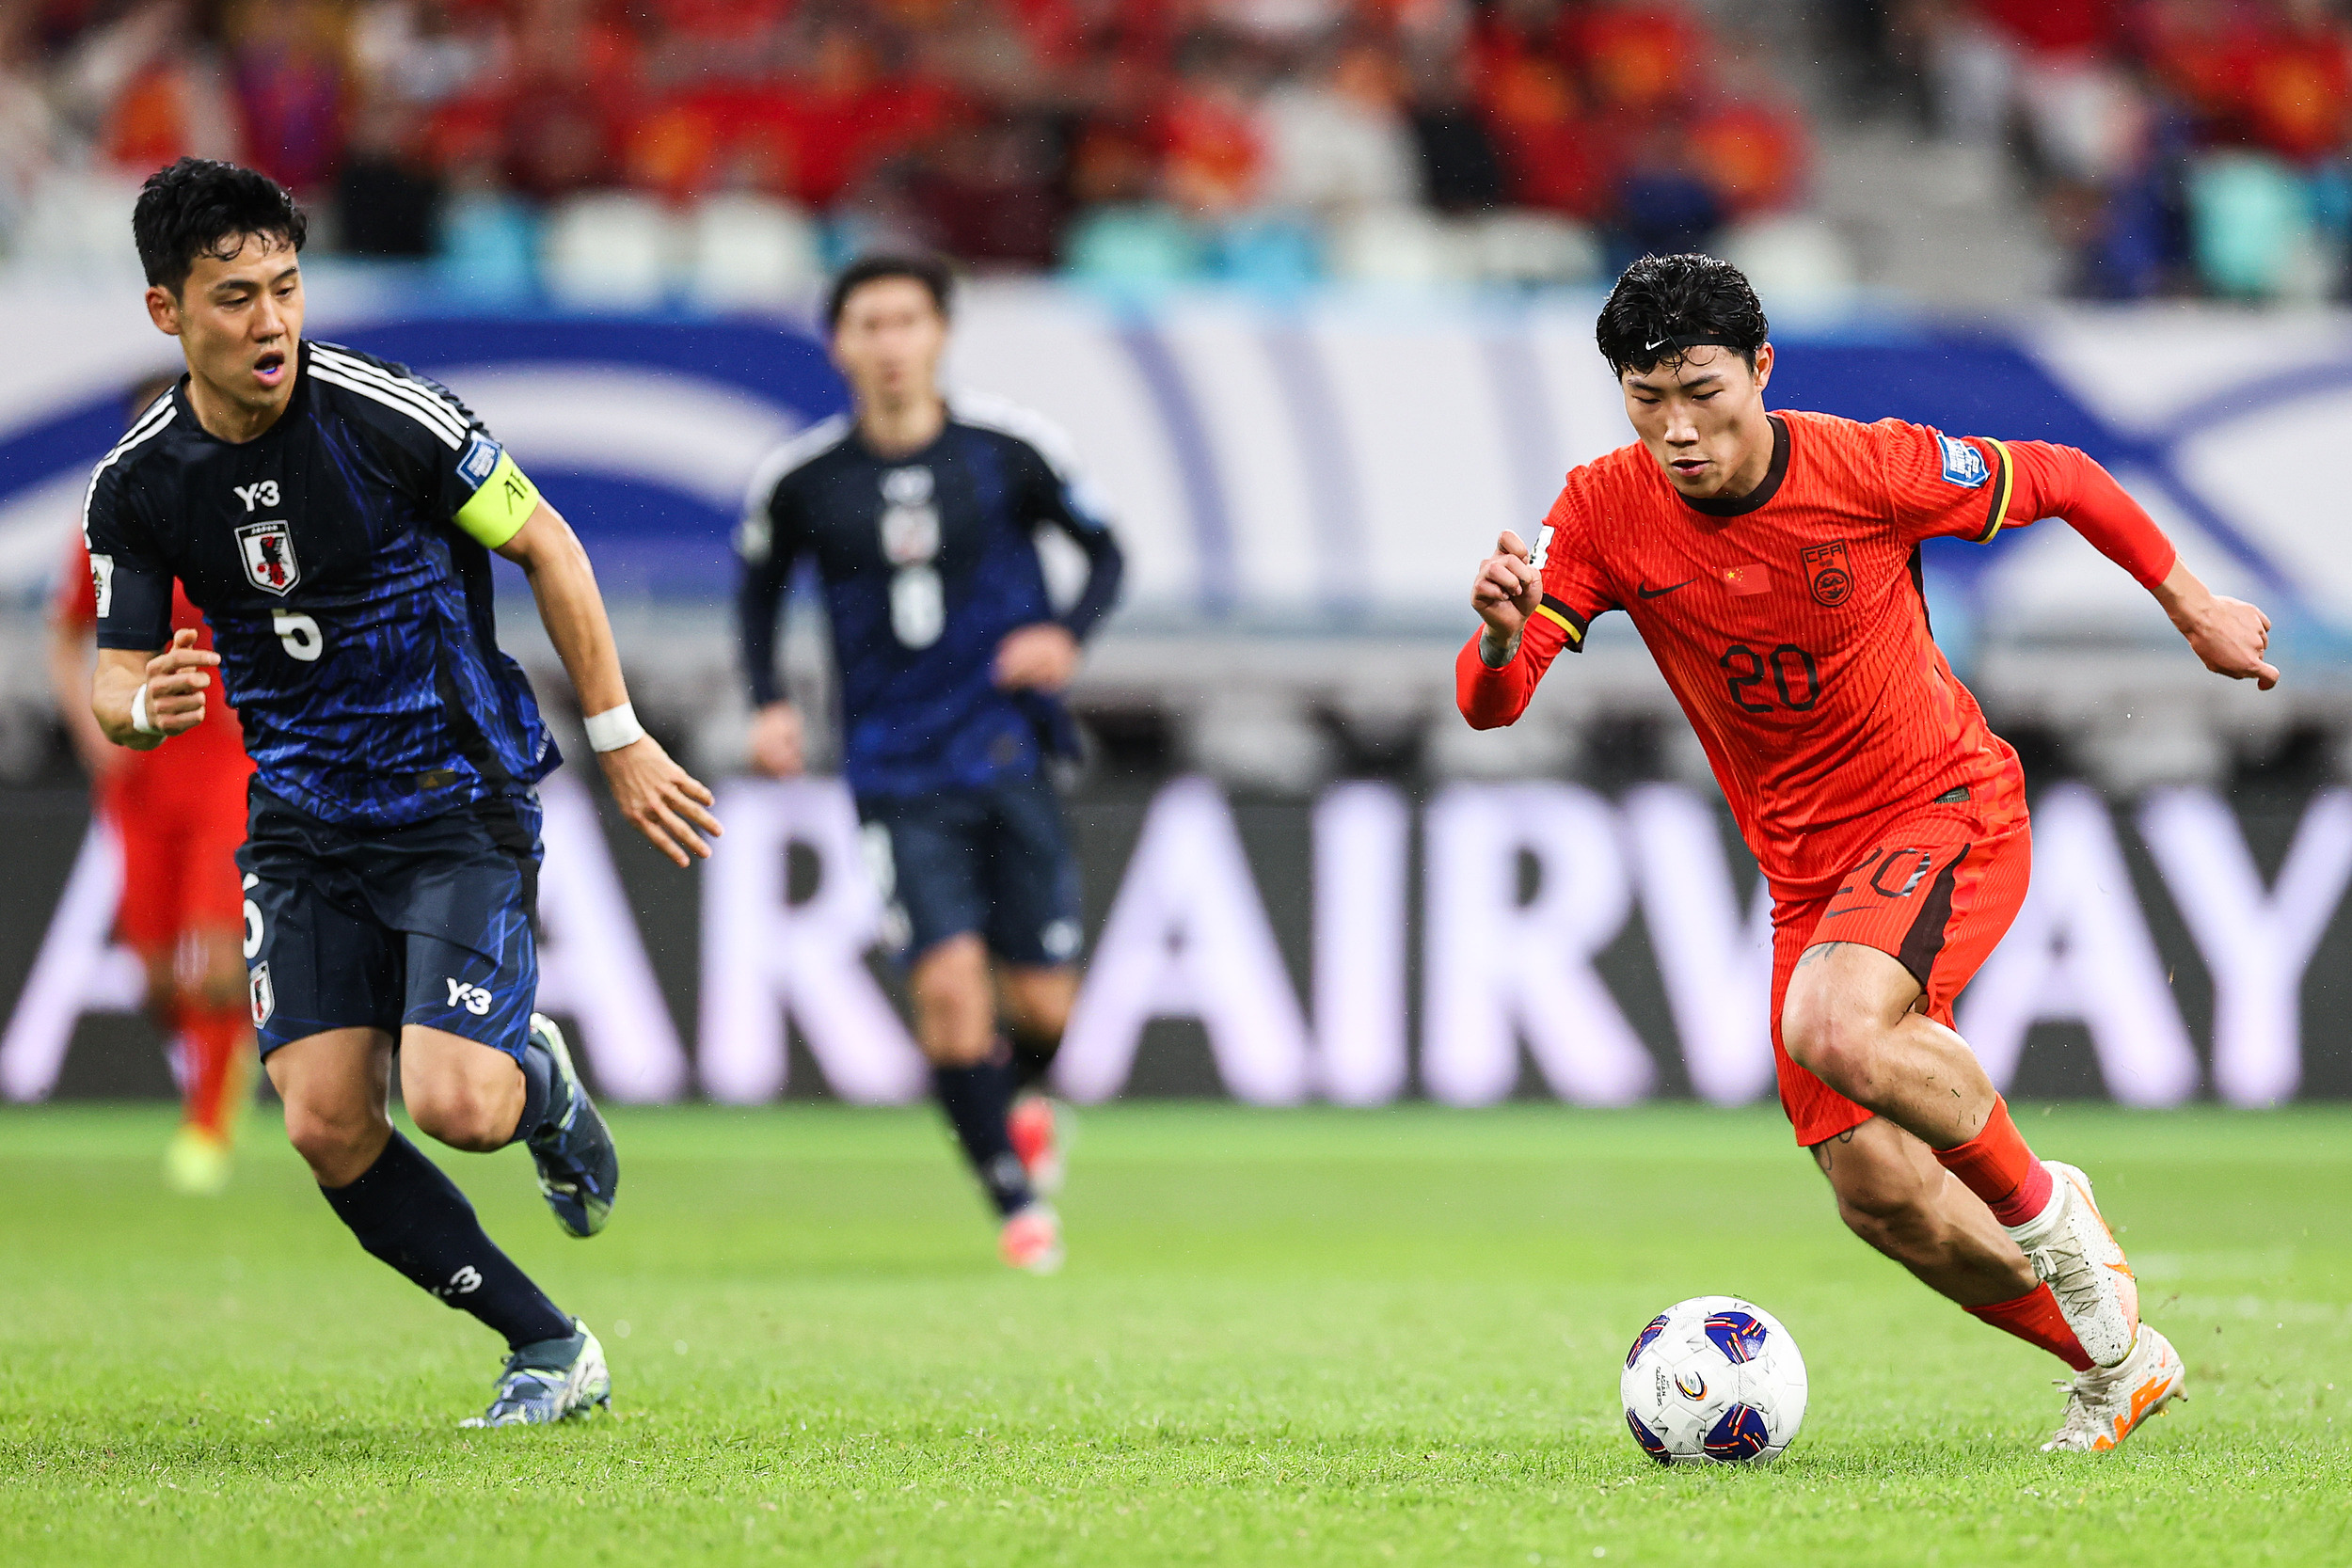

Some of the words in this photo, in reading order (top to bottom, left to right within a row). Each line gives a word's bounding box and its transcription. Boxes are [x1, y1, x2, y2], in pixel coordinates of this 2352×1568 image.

[1805, 545, 1842, 562] CFA
[1720, 643, 1820, 713] 20
[0, 776, 935, 1104] AAR
